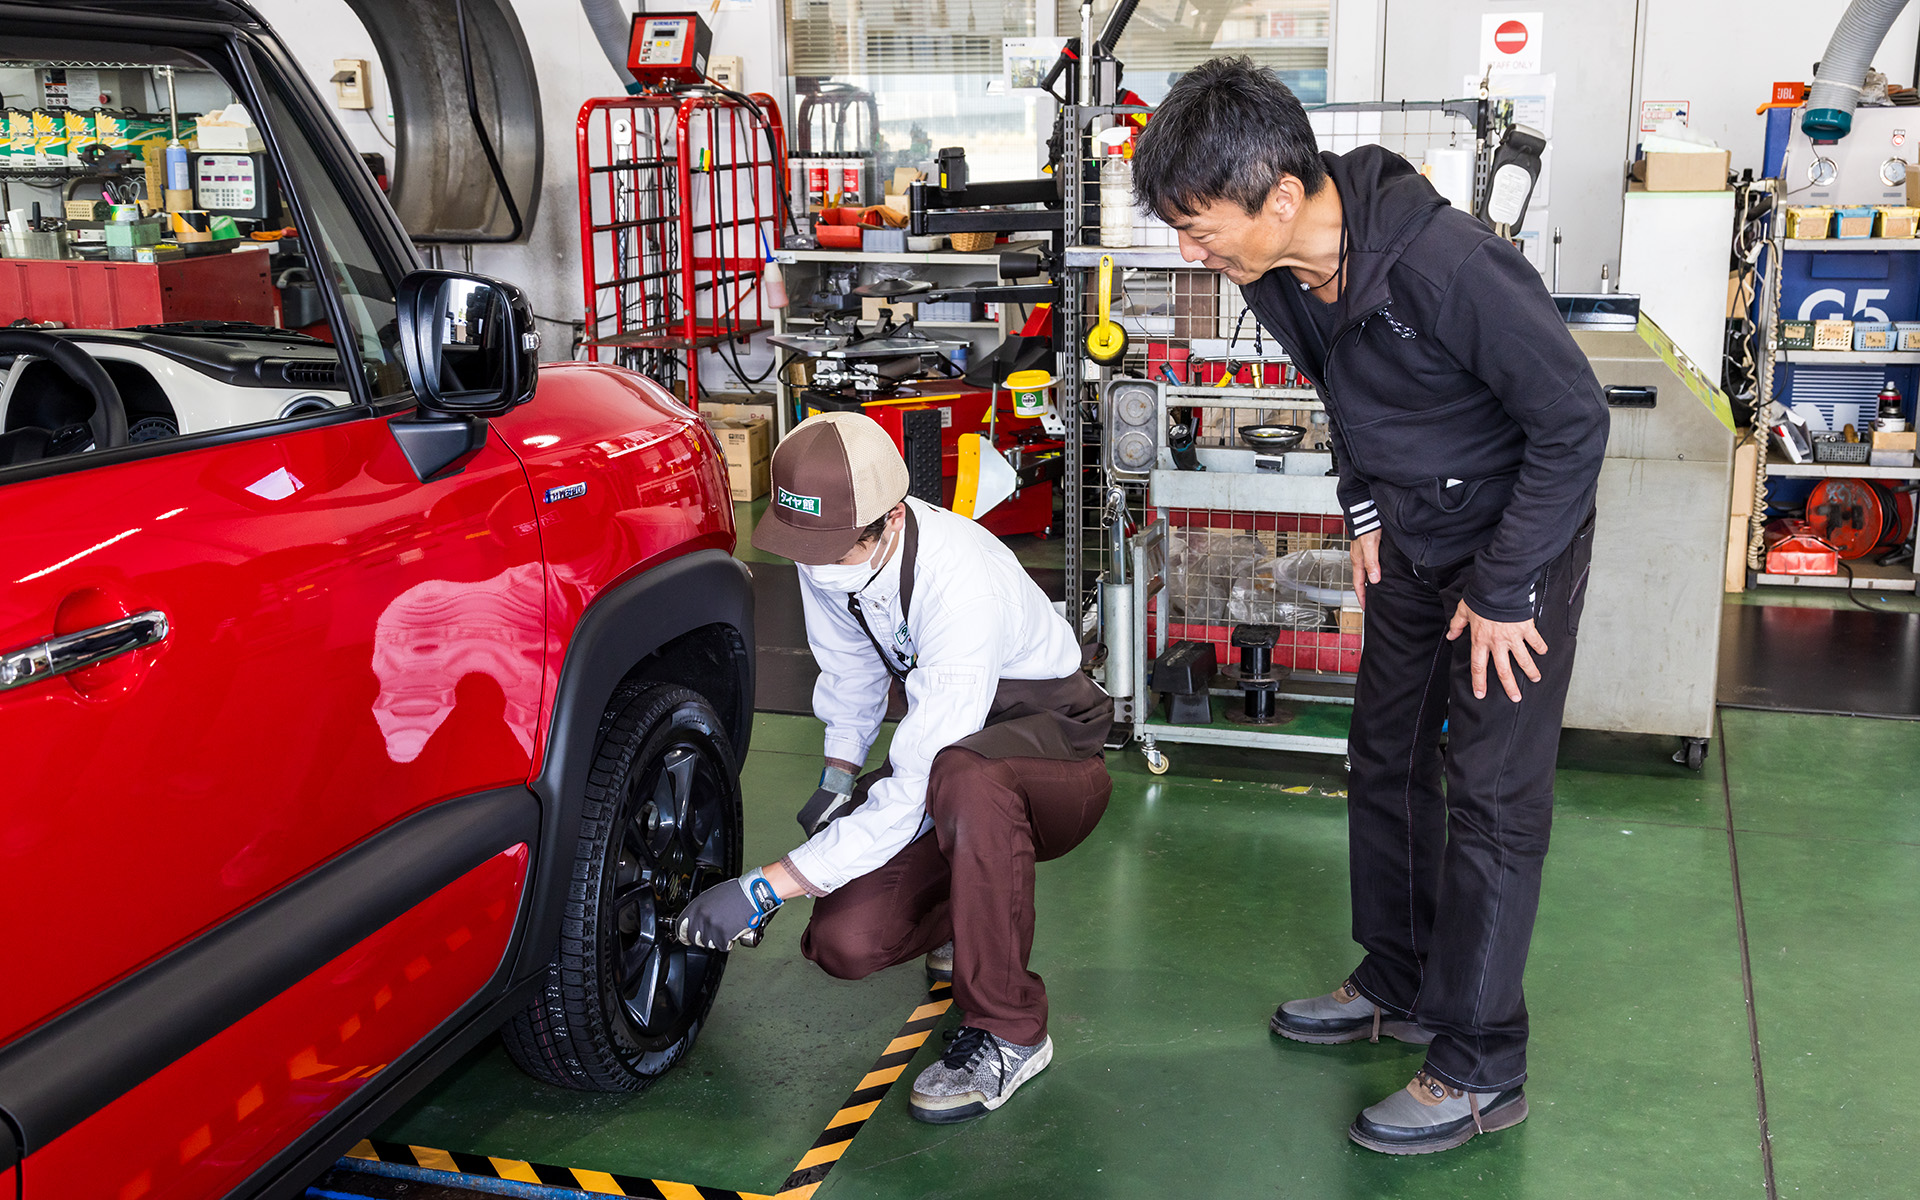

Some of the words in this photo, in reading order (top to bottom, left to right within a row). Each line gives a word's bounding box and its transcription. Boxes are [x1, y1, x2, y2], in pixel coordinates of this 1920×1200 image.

[1512, 60, 1534, 69] ONLY
[1777, 88, 1795, 99] JBL
[780, 491, 815, 511] タイヤ館
